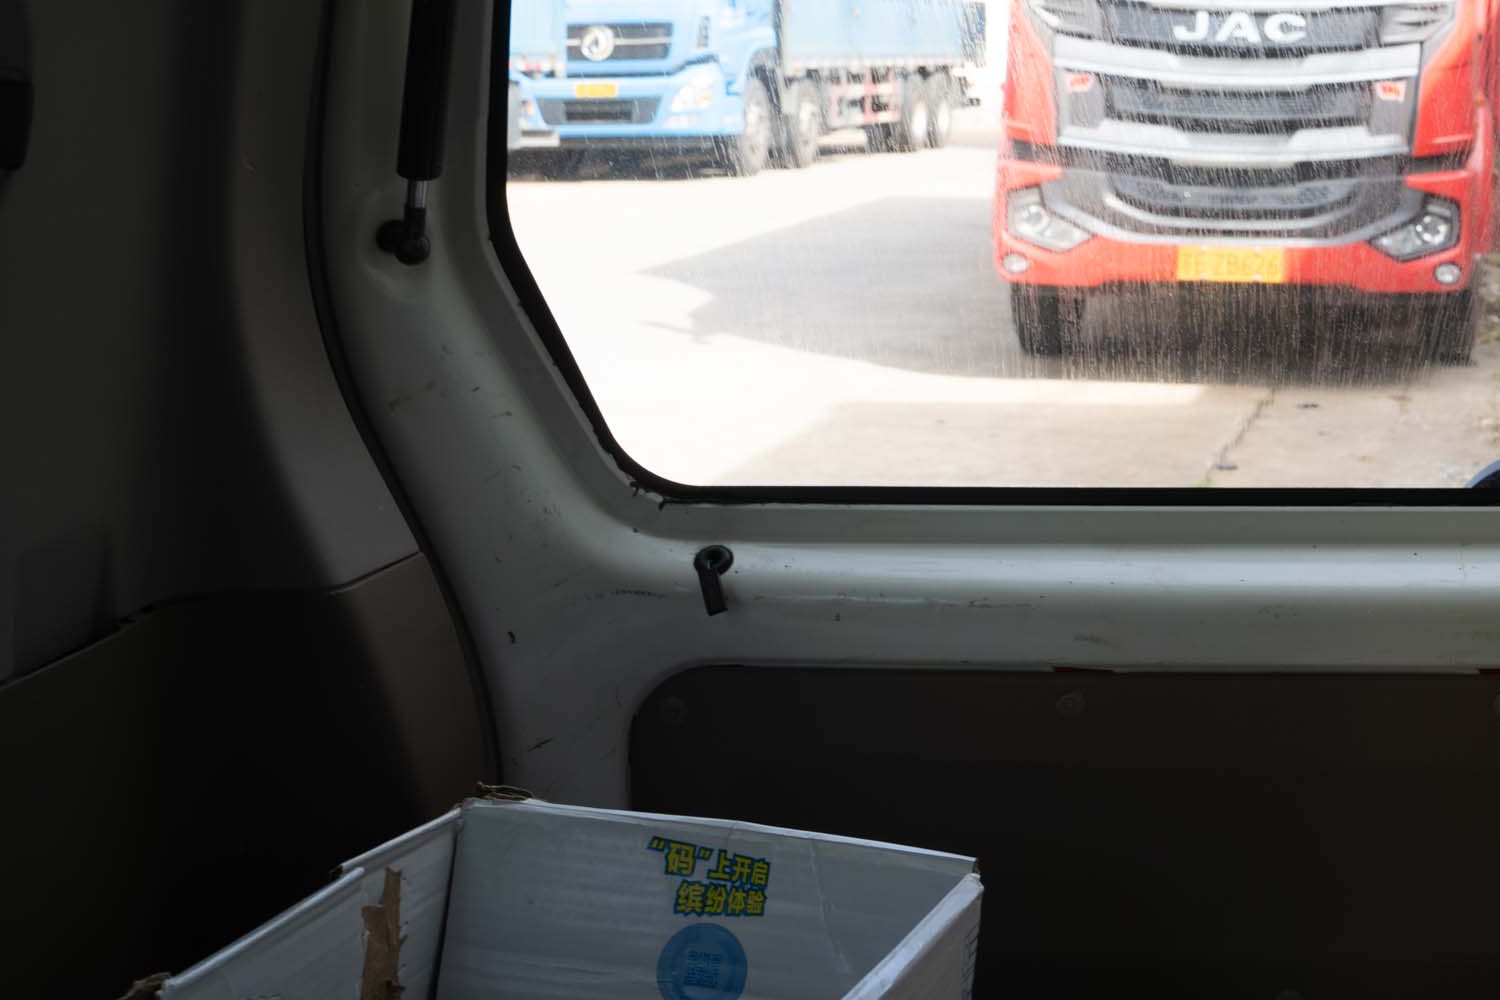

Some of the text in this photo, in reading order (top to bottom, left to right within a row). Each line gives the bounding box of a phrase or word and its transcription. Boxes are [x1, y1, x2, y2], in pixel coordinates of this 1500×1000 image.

[1172, 10, 1308, 43] JAC
[674, 880, 767, 916] 缤纷体验
